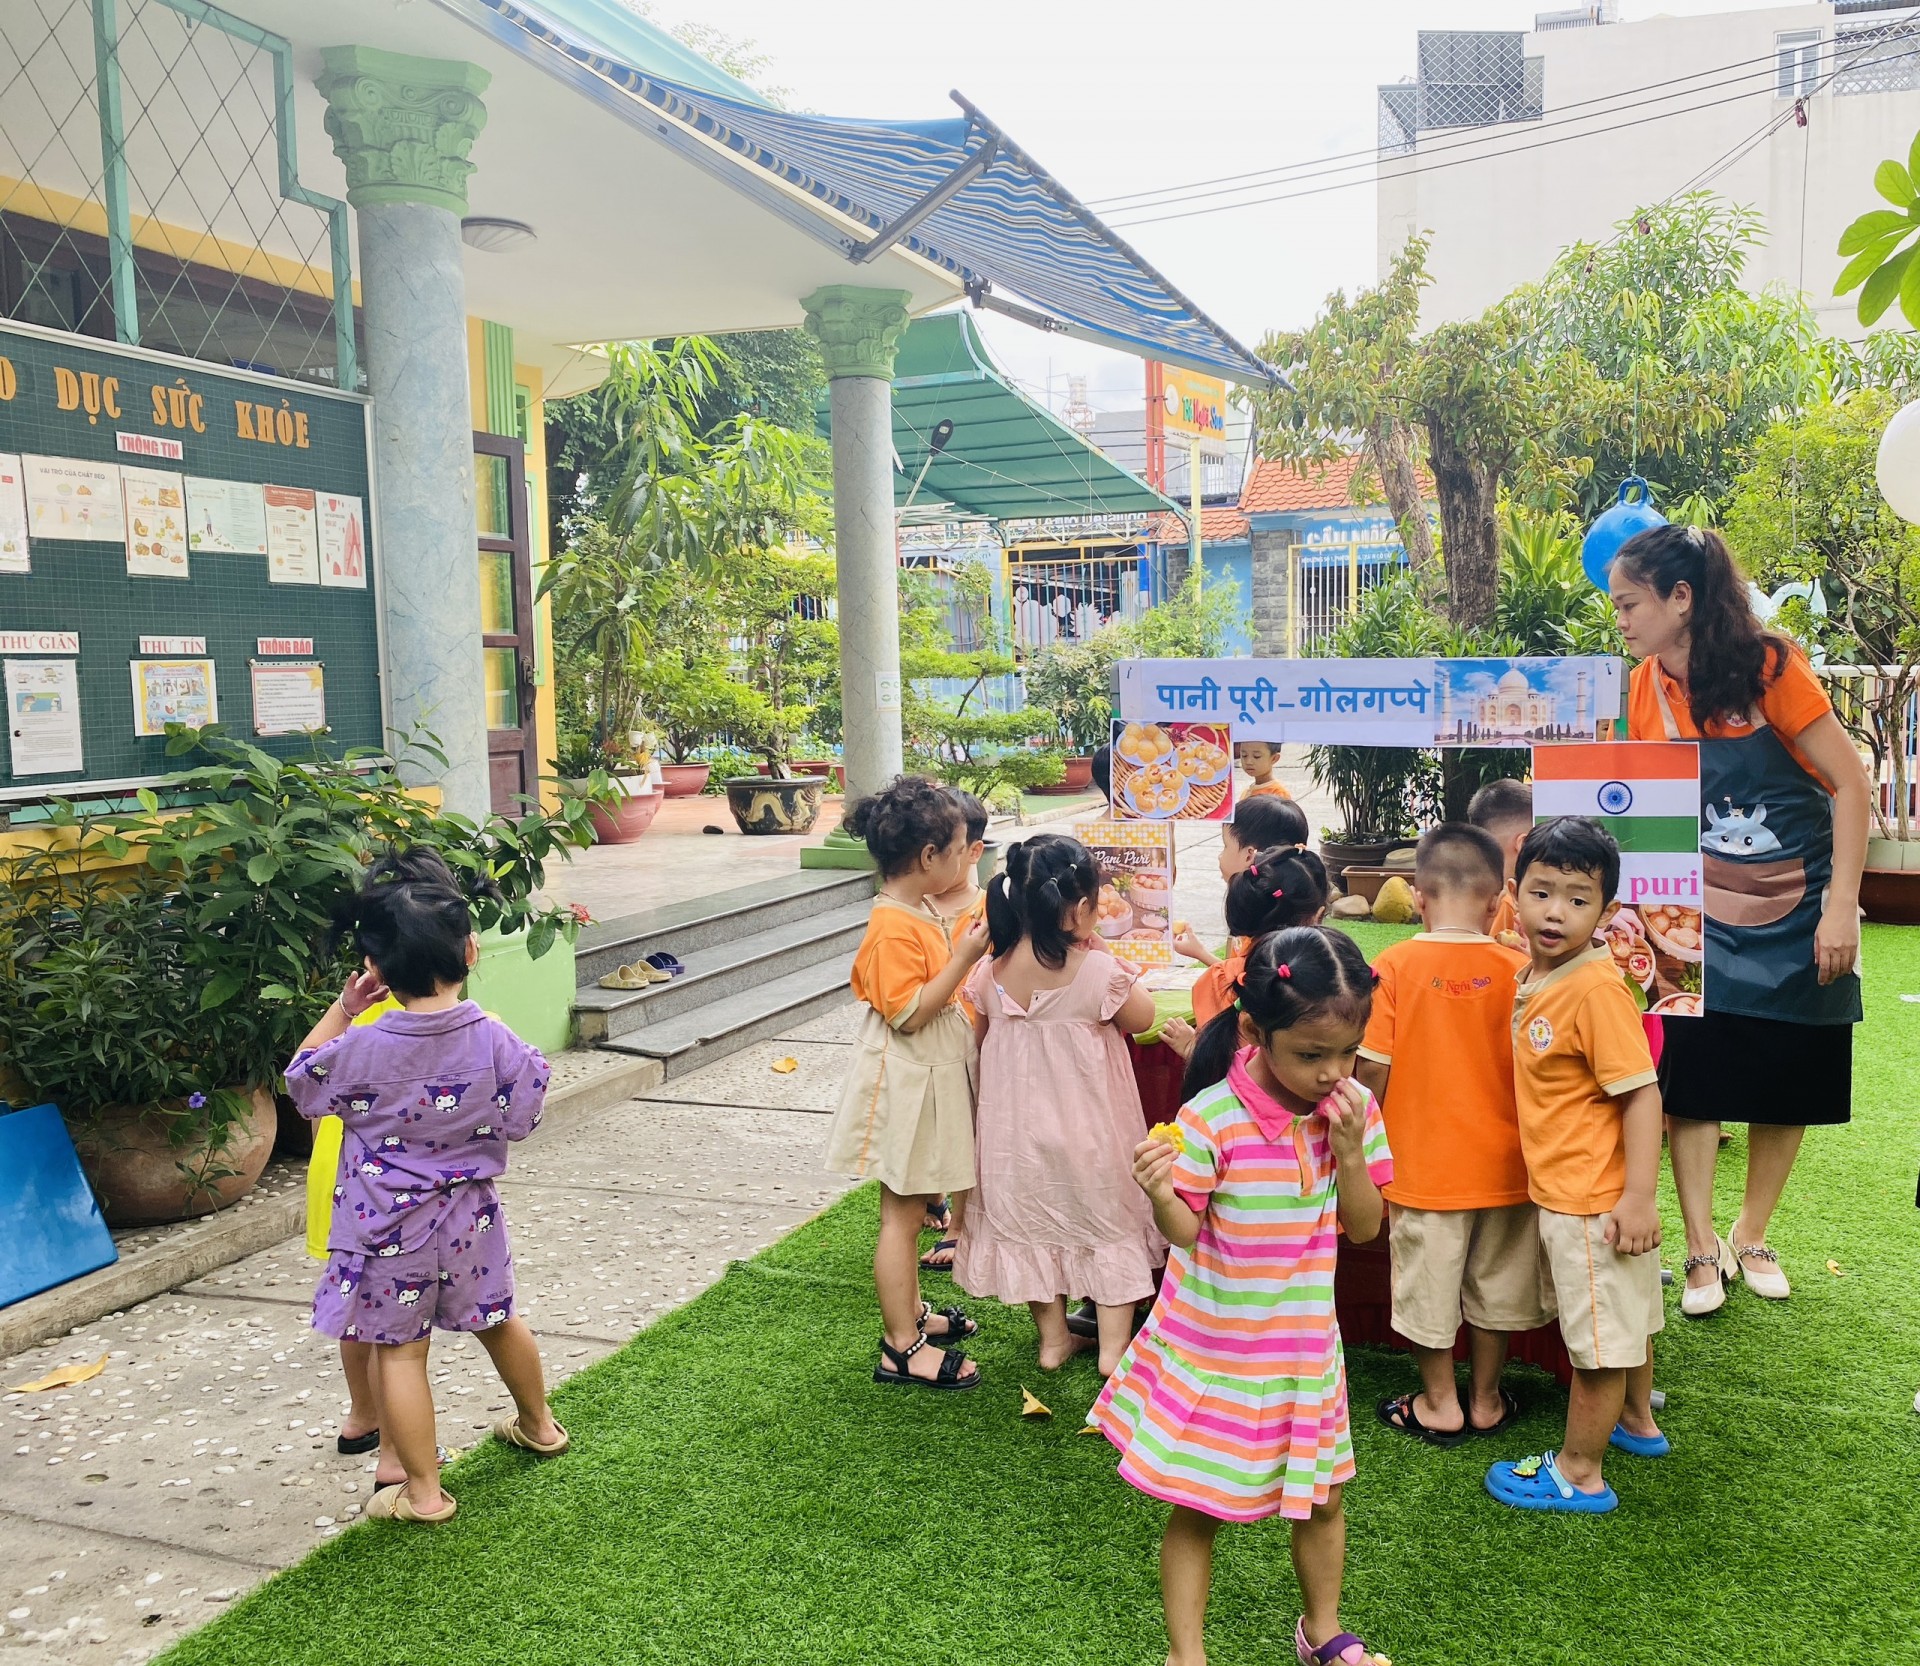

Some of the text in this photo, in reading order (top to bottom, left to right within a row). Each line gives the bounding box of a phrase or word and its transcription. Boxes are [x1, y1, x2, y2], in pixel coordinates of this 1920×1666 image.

[53, 367, 122, 425] DỤC
[151, 378, 206, 433] SỨC
[234, 398, 310, 449] KHỎE
[120, 435, 180, 458] THÔNG TIN
[1, 633, 78, 649] THƯ GIÃN
[141, 637, 205, 653] THƯ TÍN
[259, 638, 312, 654] THÔNG BÁO
[1156, 676, 1221, 711] पानी
[1094, 850, 1151, 865] Pani Puri
[1629, 869, 1700, 903] puri
